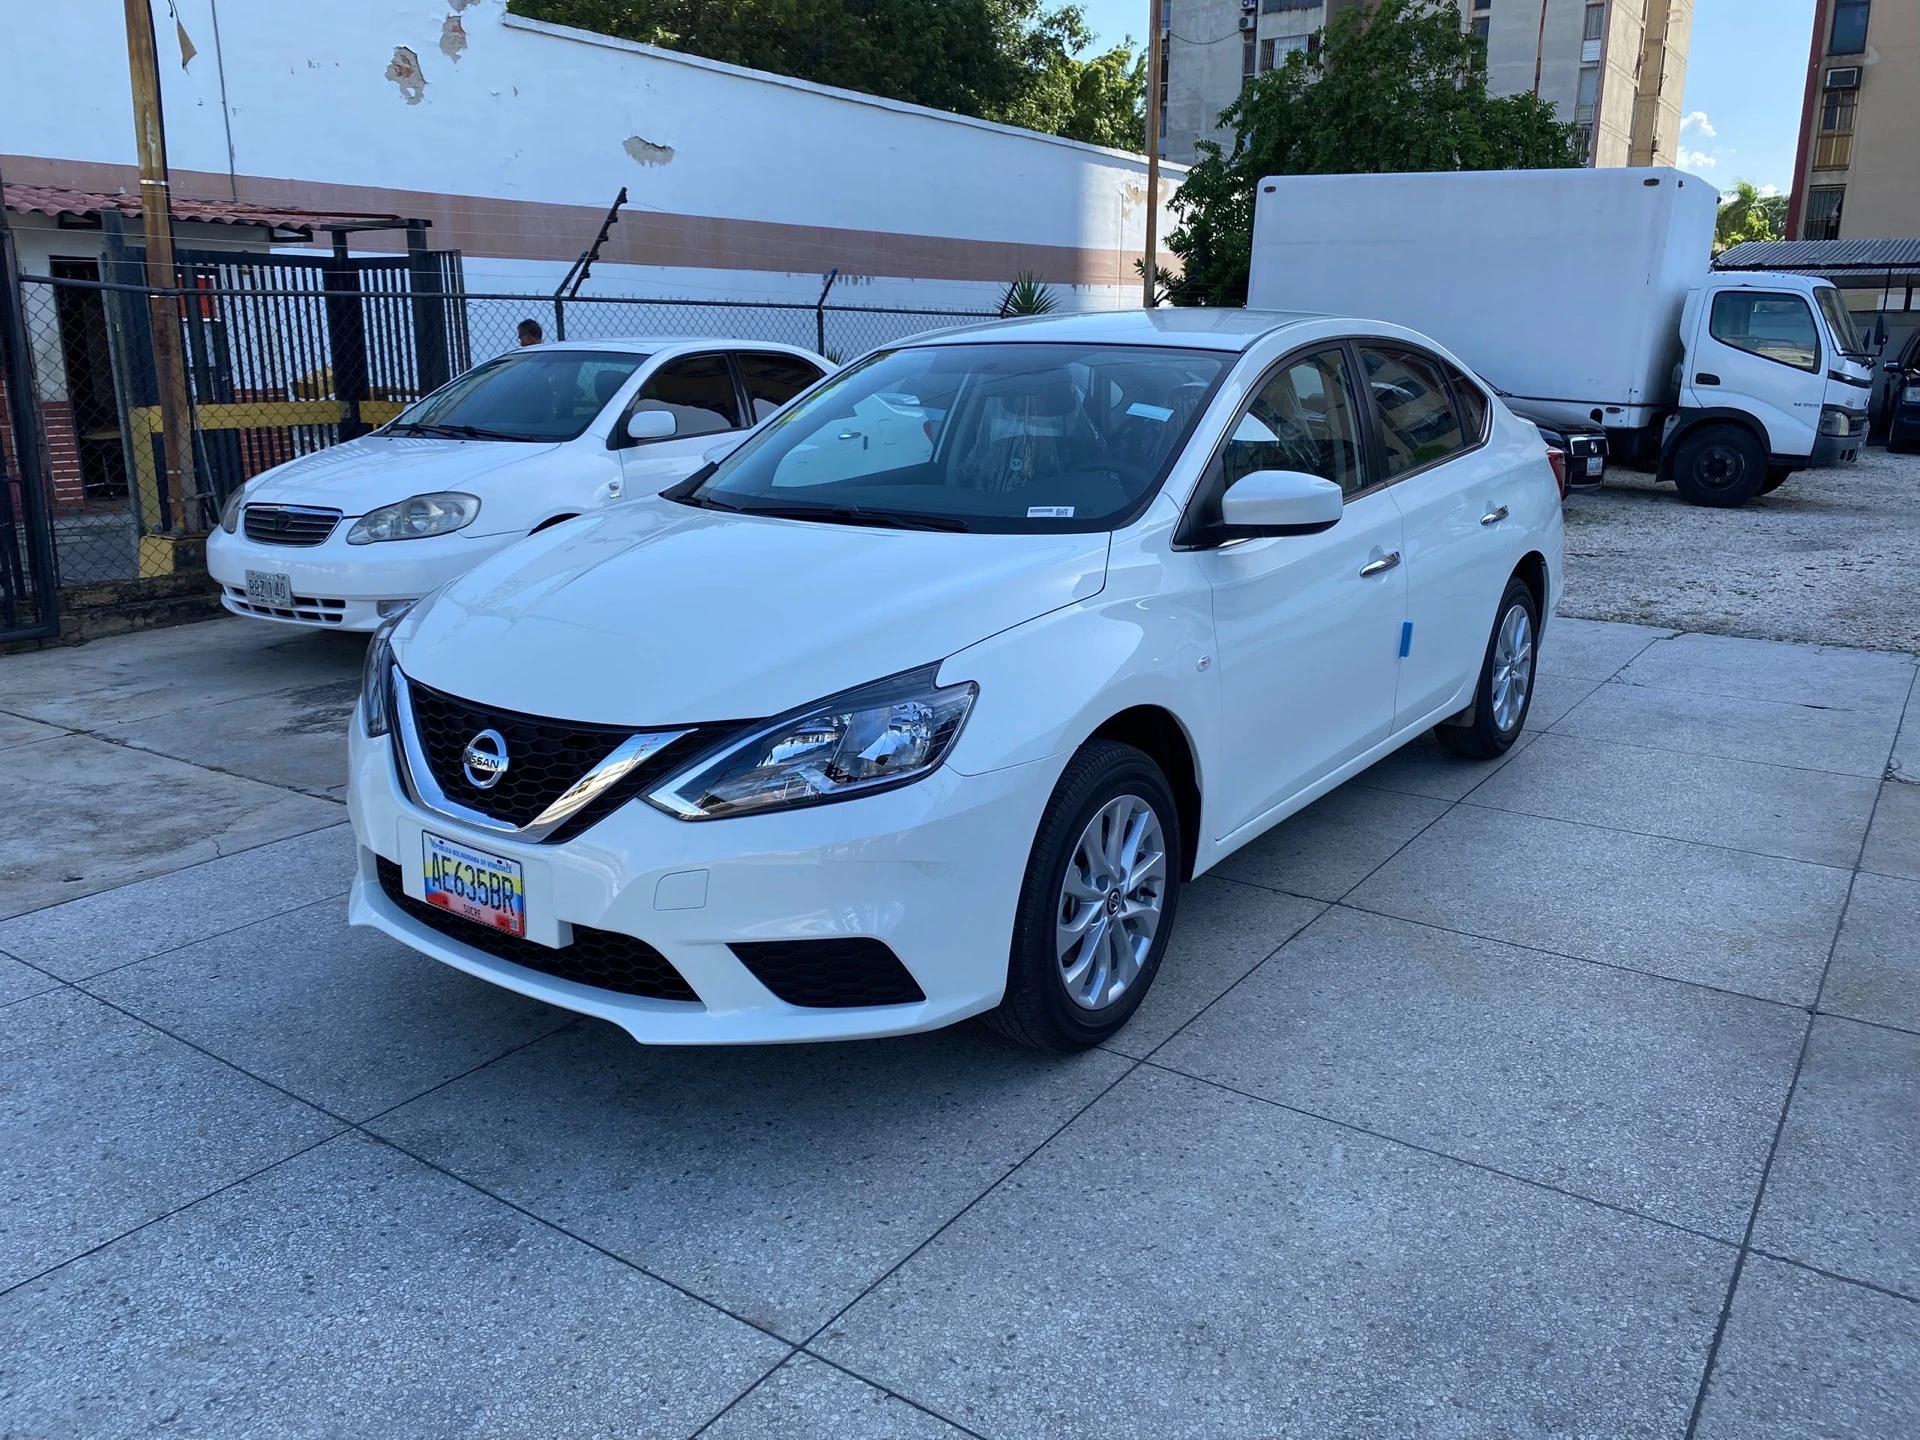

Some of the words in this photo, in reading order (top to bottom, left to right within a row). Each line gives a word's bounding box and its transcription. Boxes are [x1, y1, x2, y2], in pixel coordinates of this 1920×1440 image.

[464, 749, 500, 769] NISSAN
[453, 850, 480, 863] BOLIVARIANA
[480, 859, 487, 867] DE
[432, 852, 515, 916] AE635BR
[463, 904, 482, 919] SUCRE
